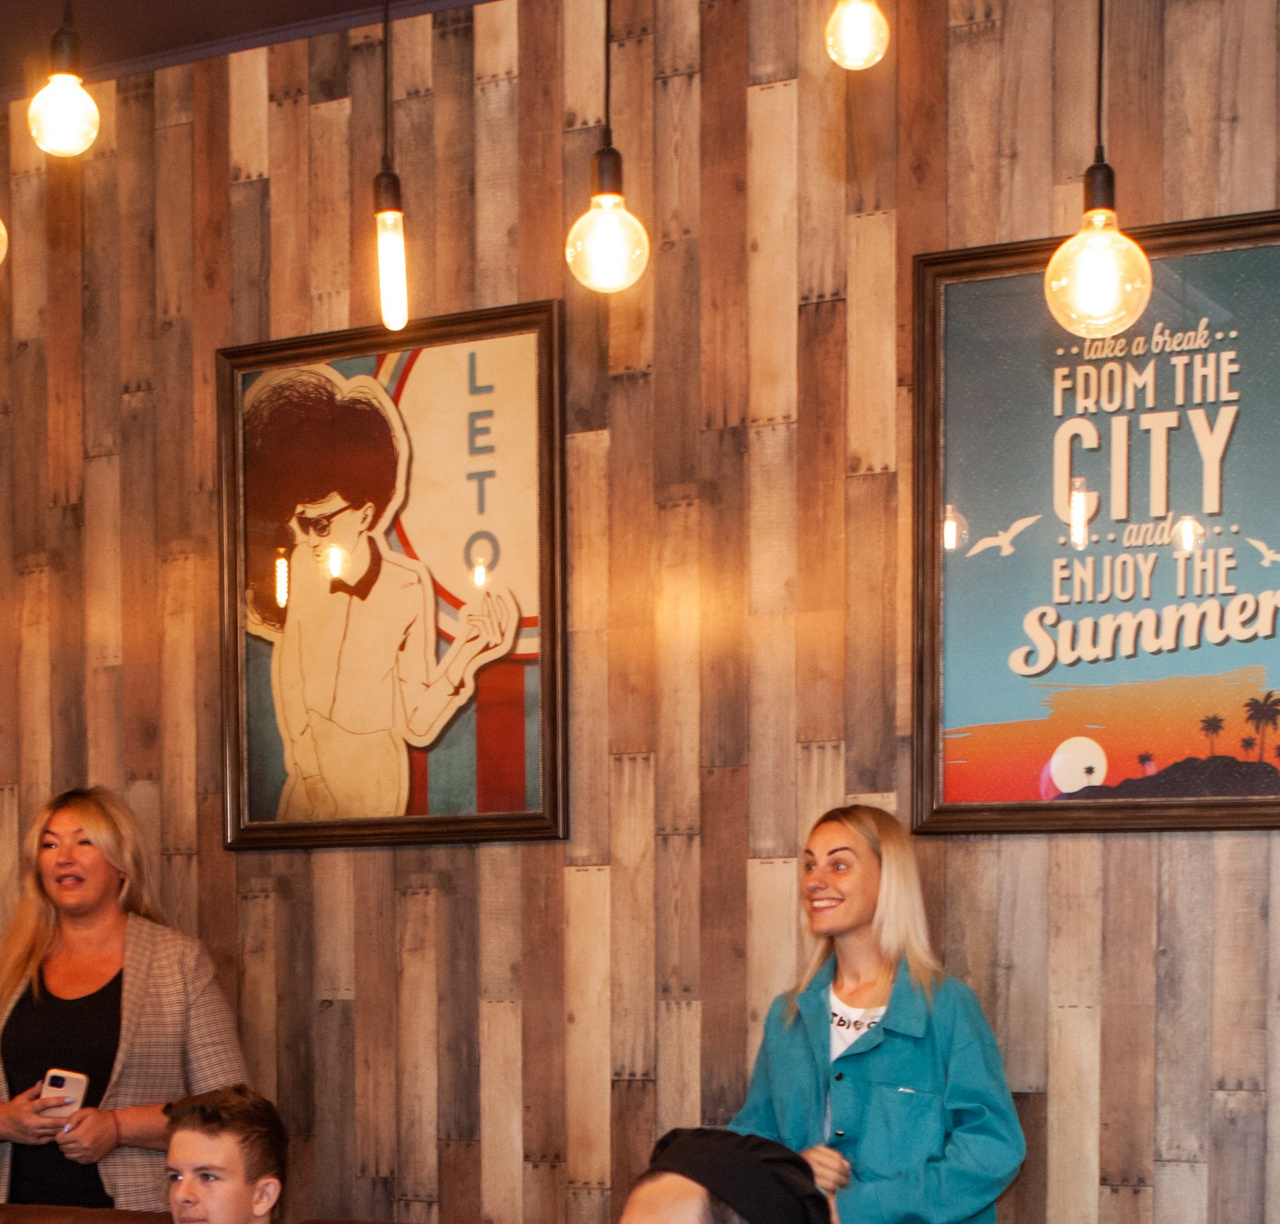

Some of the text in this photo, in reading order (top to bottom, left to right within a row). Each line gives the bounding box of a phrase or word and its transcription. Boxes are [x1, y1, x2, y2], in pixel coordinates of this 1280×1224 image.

[1083, 317, 1212, 360] take a break
[1053, 350, 1241, 417] FROM THE
[463, 351, 500, 575] LETO
[1053, 405, 1240, 527] CITY
[1122, 511, 1175, 548] and
[1052, 547, 1238, 604] ENJOY THE
[1008, 590, 1280, 676] Summer
